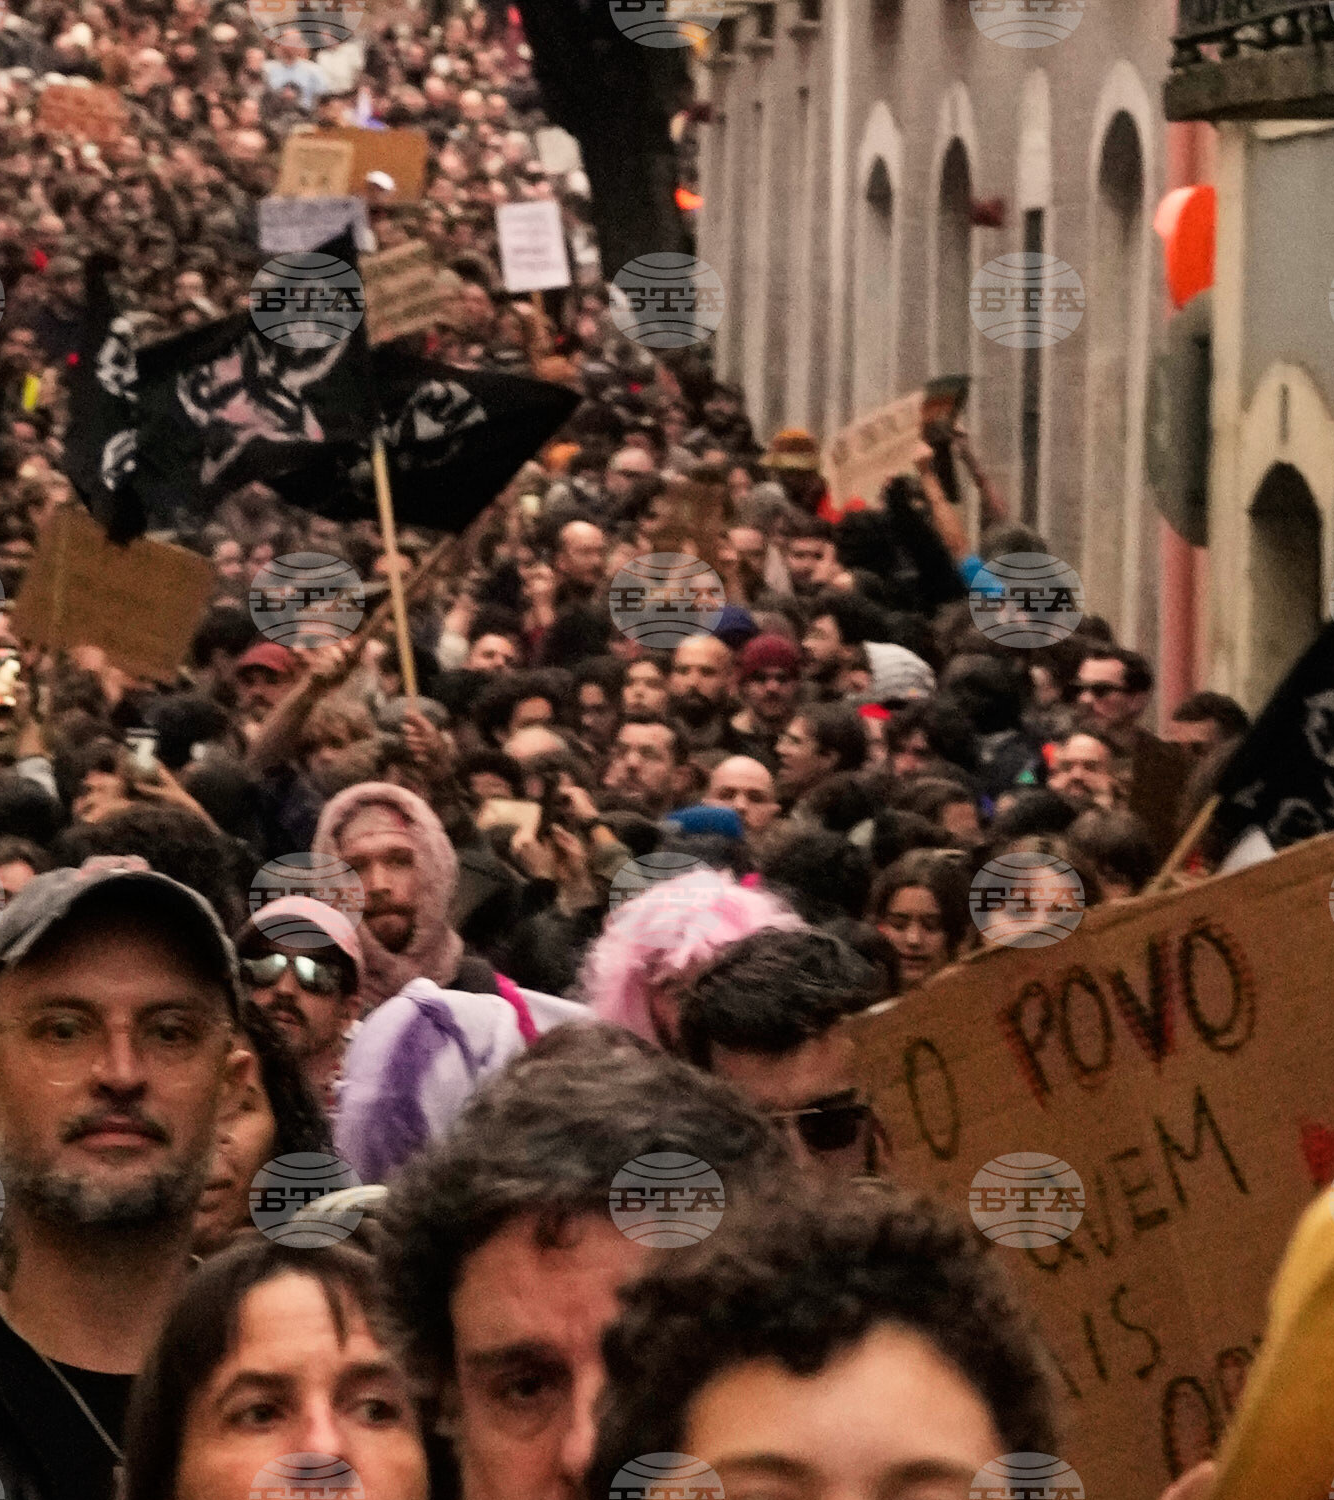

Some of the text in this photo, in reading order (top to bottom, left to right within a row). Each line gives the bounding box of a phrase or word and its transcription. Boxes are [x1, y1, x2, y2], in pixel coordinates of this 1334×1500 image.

[904, 916, 1258, 1162] O POVO
[1022, 1086, 1250, 1273] QUEM
